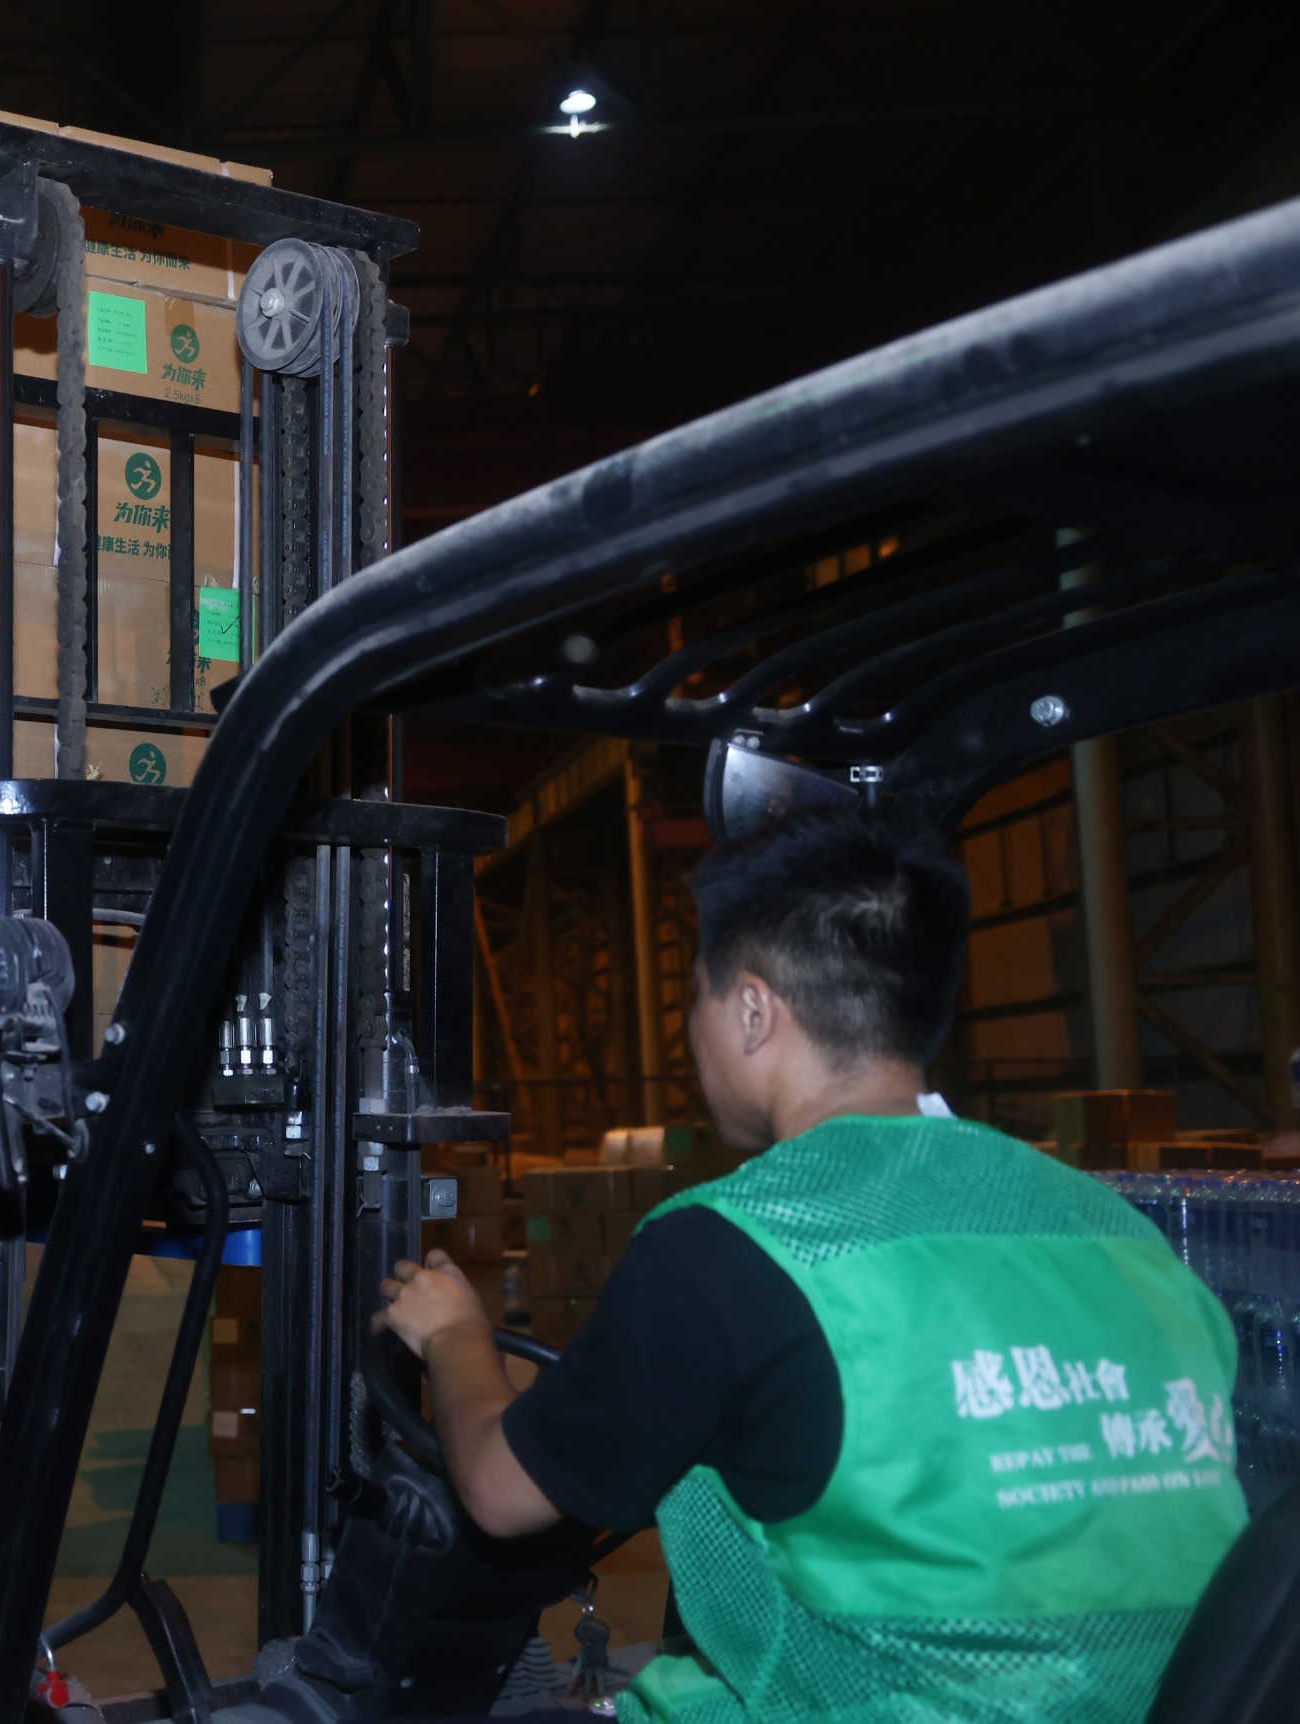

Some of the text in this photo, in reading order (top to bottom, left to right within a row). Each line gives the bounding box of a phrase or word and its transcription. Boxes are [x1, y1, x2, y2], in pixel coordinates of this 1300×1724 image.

[140, 245, 191, 271] 为你而来
[161, 363, 207, 392] 为你来
[113, 502, 171, 534] 为你来
